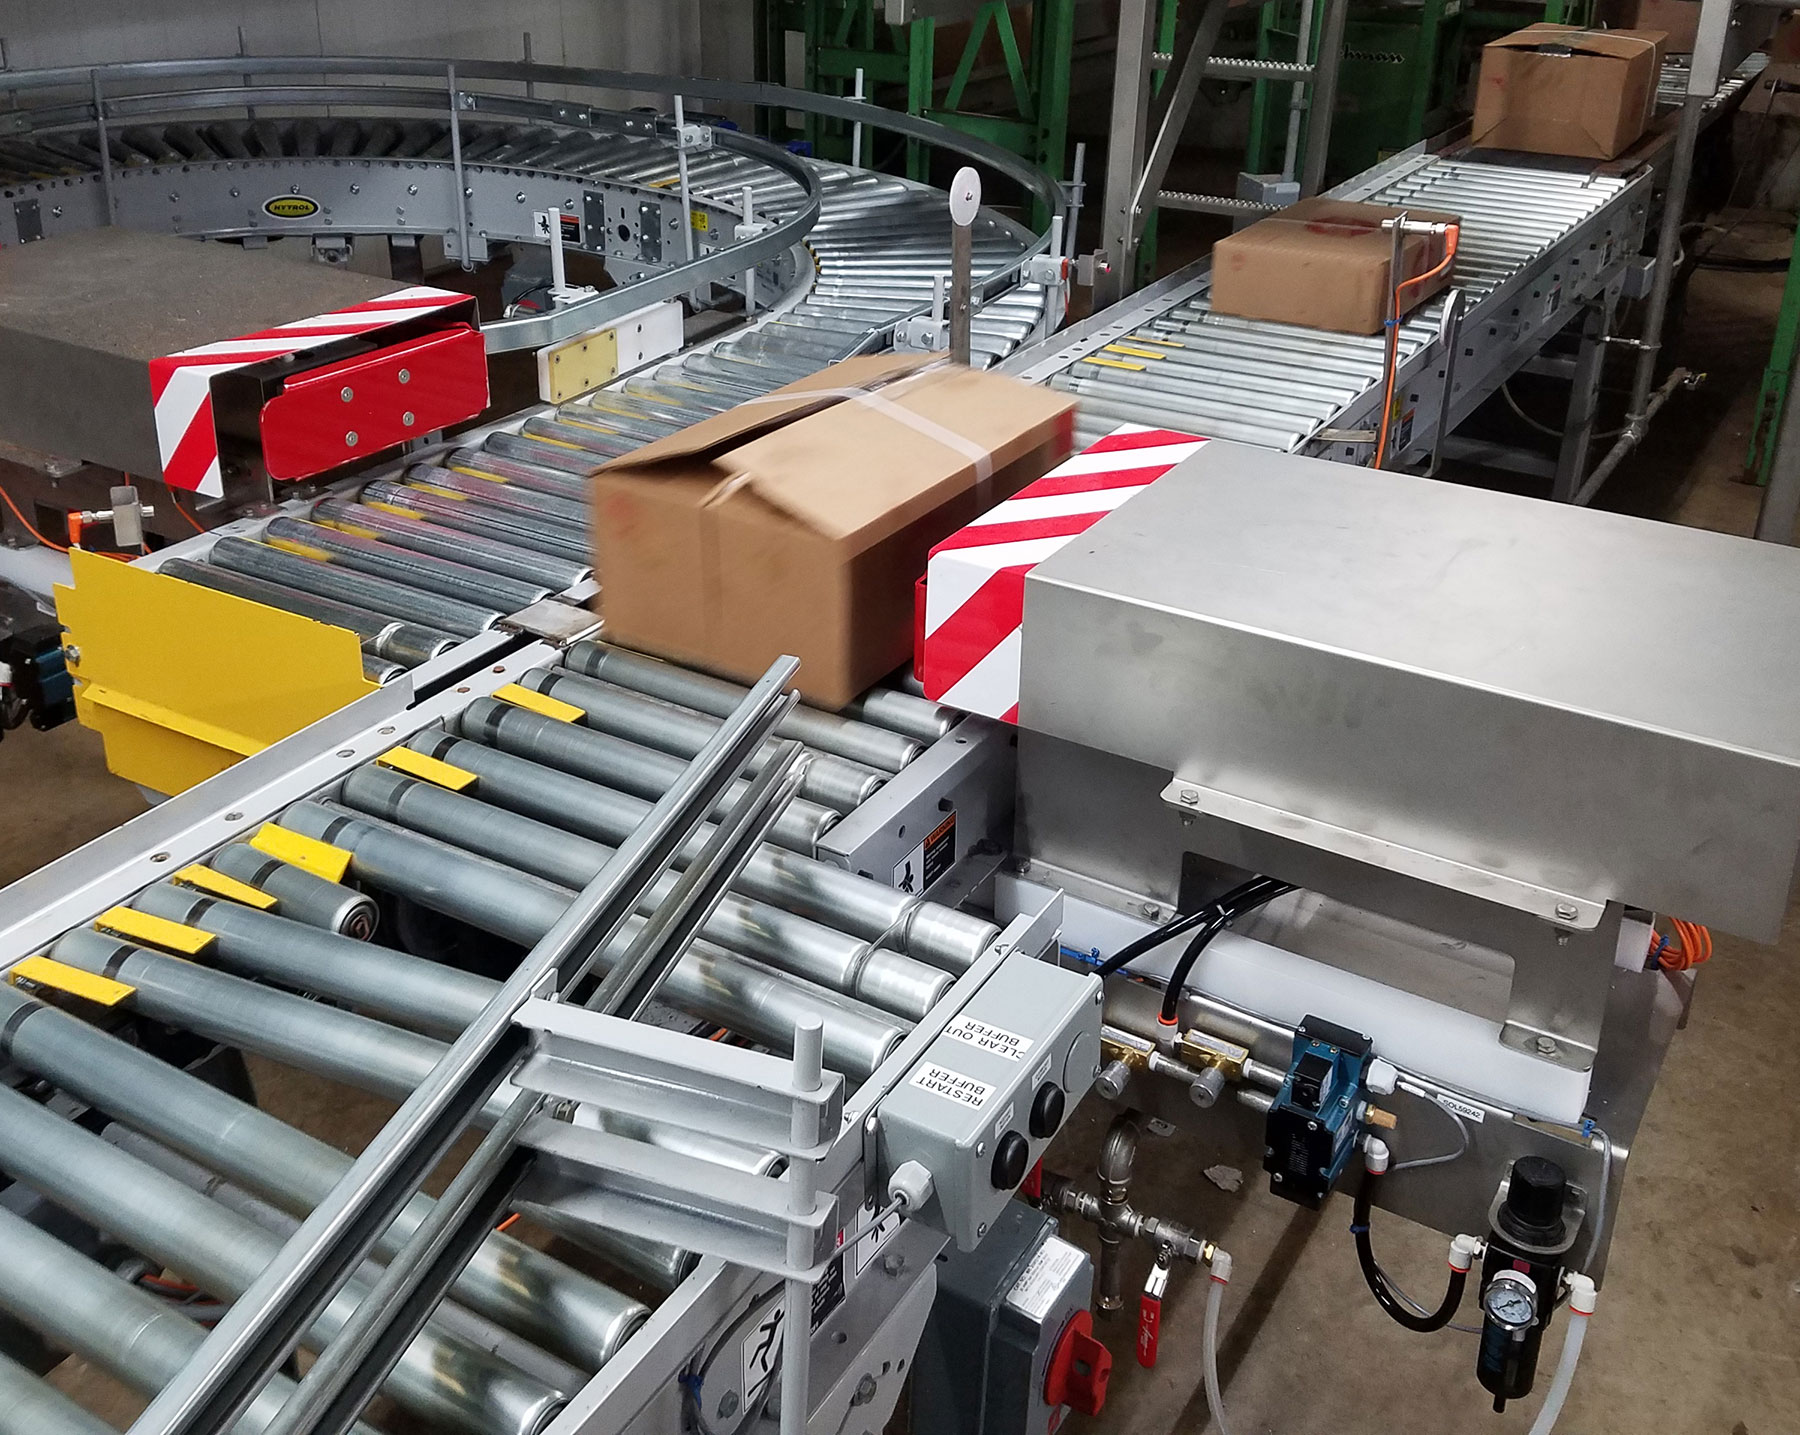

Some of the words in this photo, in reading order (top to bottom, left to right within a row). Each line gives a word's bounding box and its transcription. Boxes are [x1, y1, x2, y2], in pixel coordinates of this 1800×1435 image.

[944, 1025, 973, 1041] OUT
[964, 1021, 1020, 1047] BUFFER
[915, 1076, 984, 1107] RESTART
[928, 1068, 986, 1096] BUFFER
